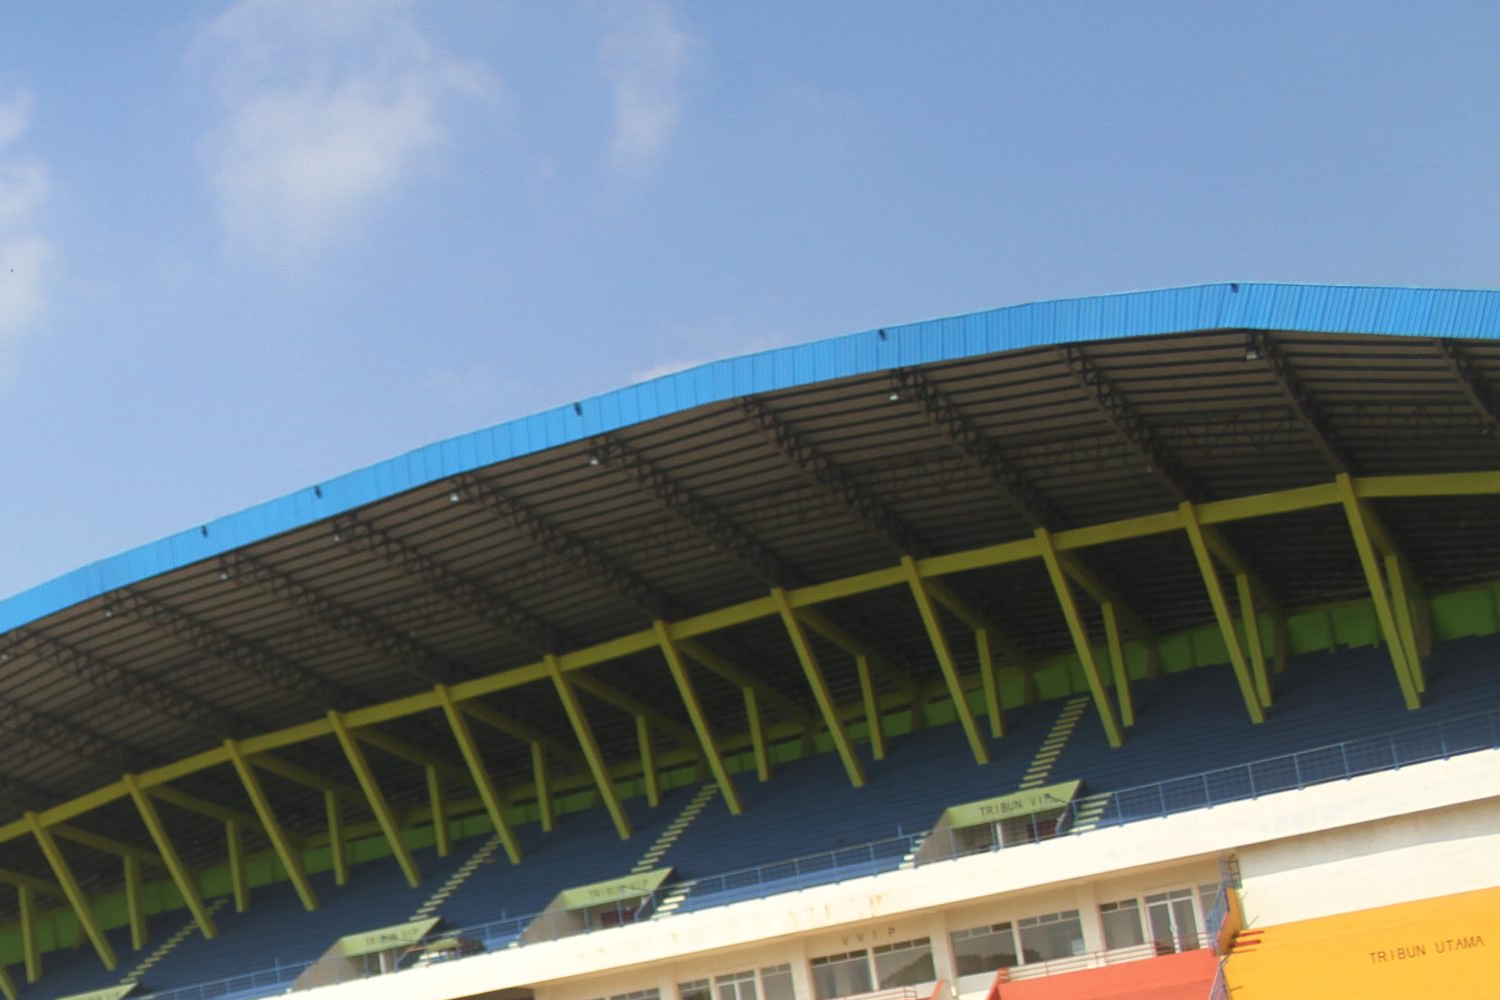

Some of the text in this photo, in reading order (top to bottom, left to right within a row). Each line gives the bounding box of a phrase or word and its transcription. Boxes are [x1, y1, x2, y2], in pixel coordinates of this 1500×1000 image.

[980, 800, 1023, 816] TRIBUN
[1369, 936, 1485, 964] TRIBUN UTAMA
